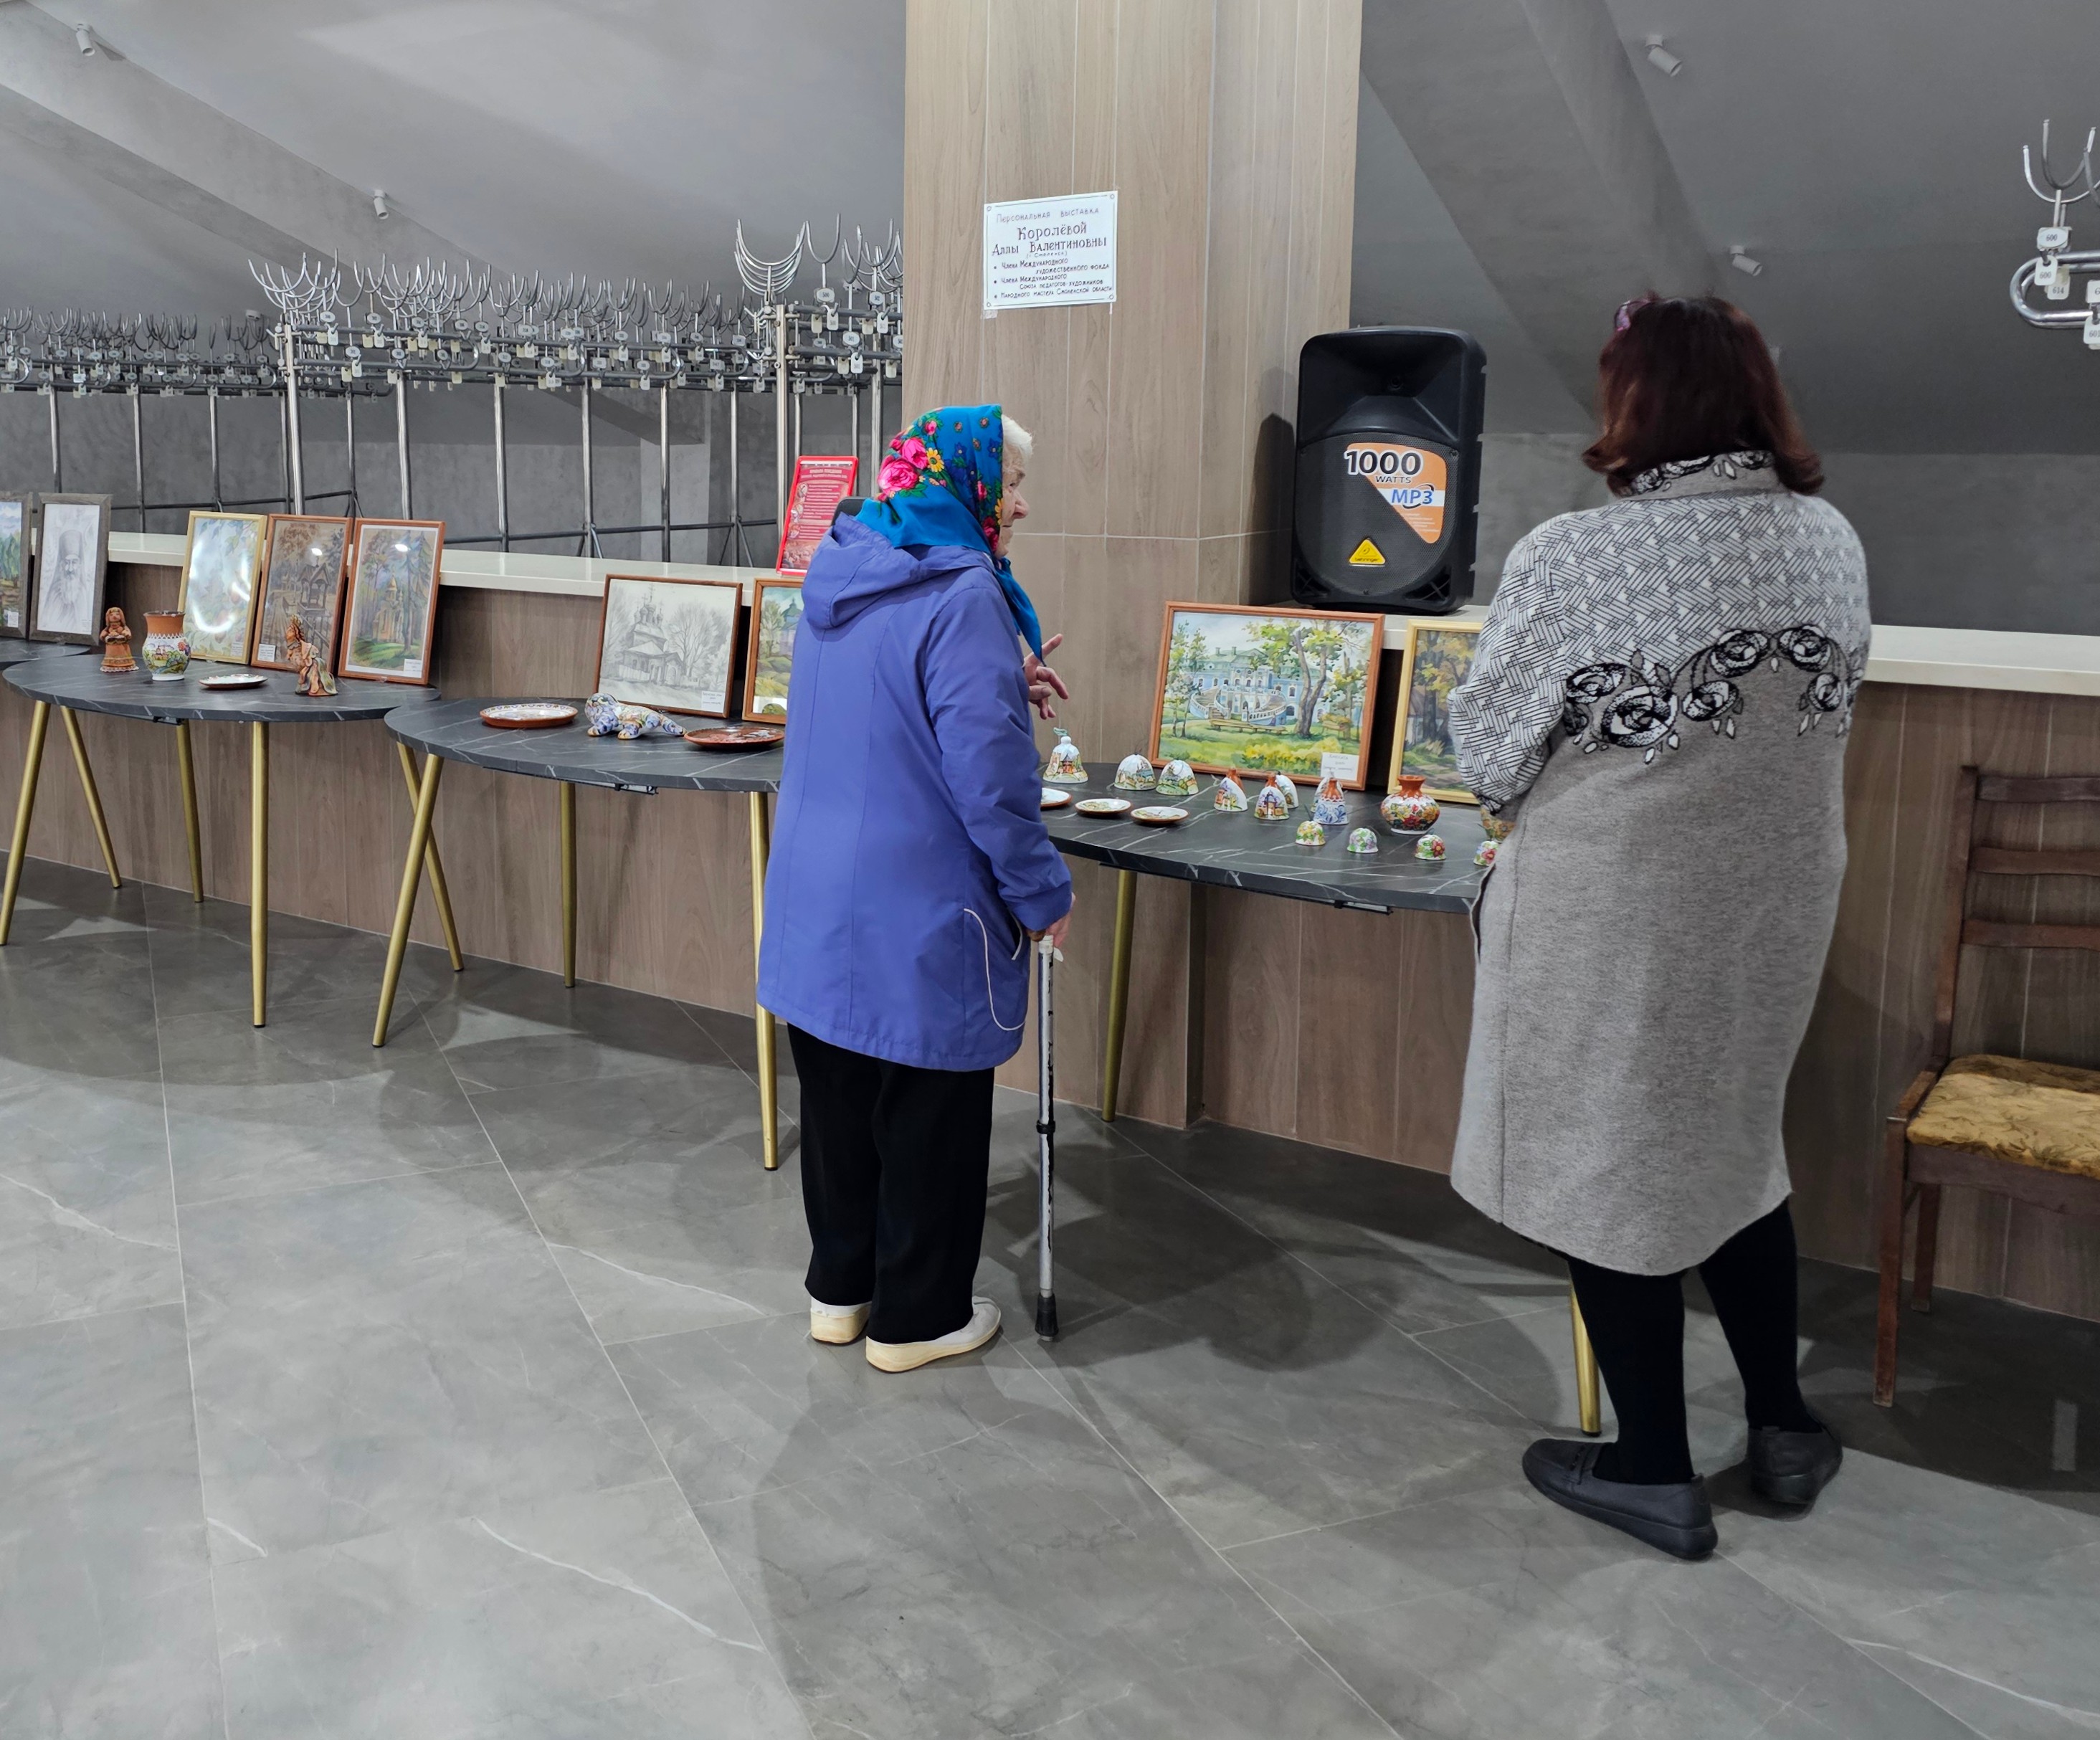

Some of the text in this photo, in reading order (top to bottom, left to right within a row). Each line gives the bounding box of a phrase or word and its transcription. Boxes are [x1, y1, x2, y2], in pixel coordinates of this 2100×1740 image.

[1017, 222, 1087, 241] Королёвой
[992, 244, 1019, 256] Аллы
[1344, 449, 1422, 476] 1000
[1392, 489, 1433, 505] MP3
